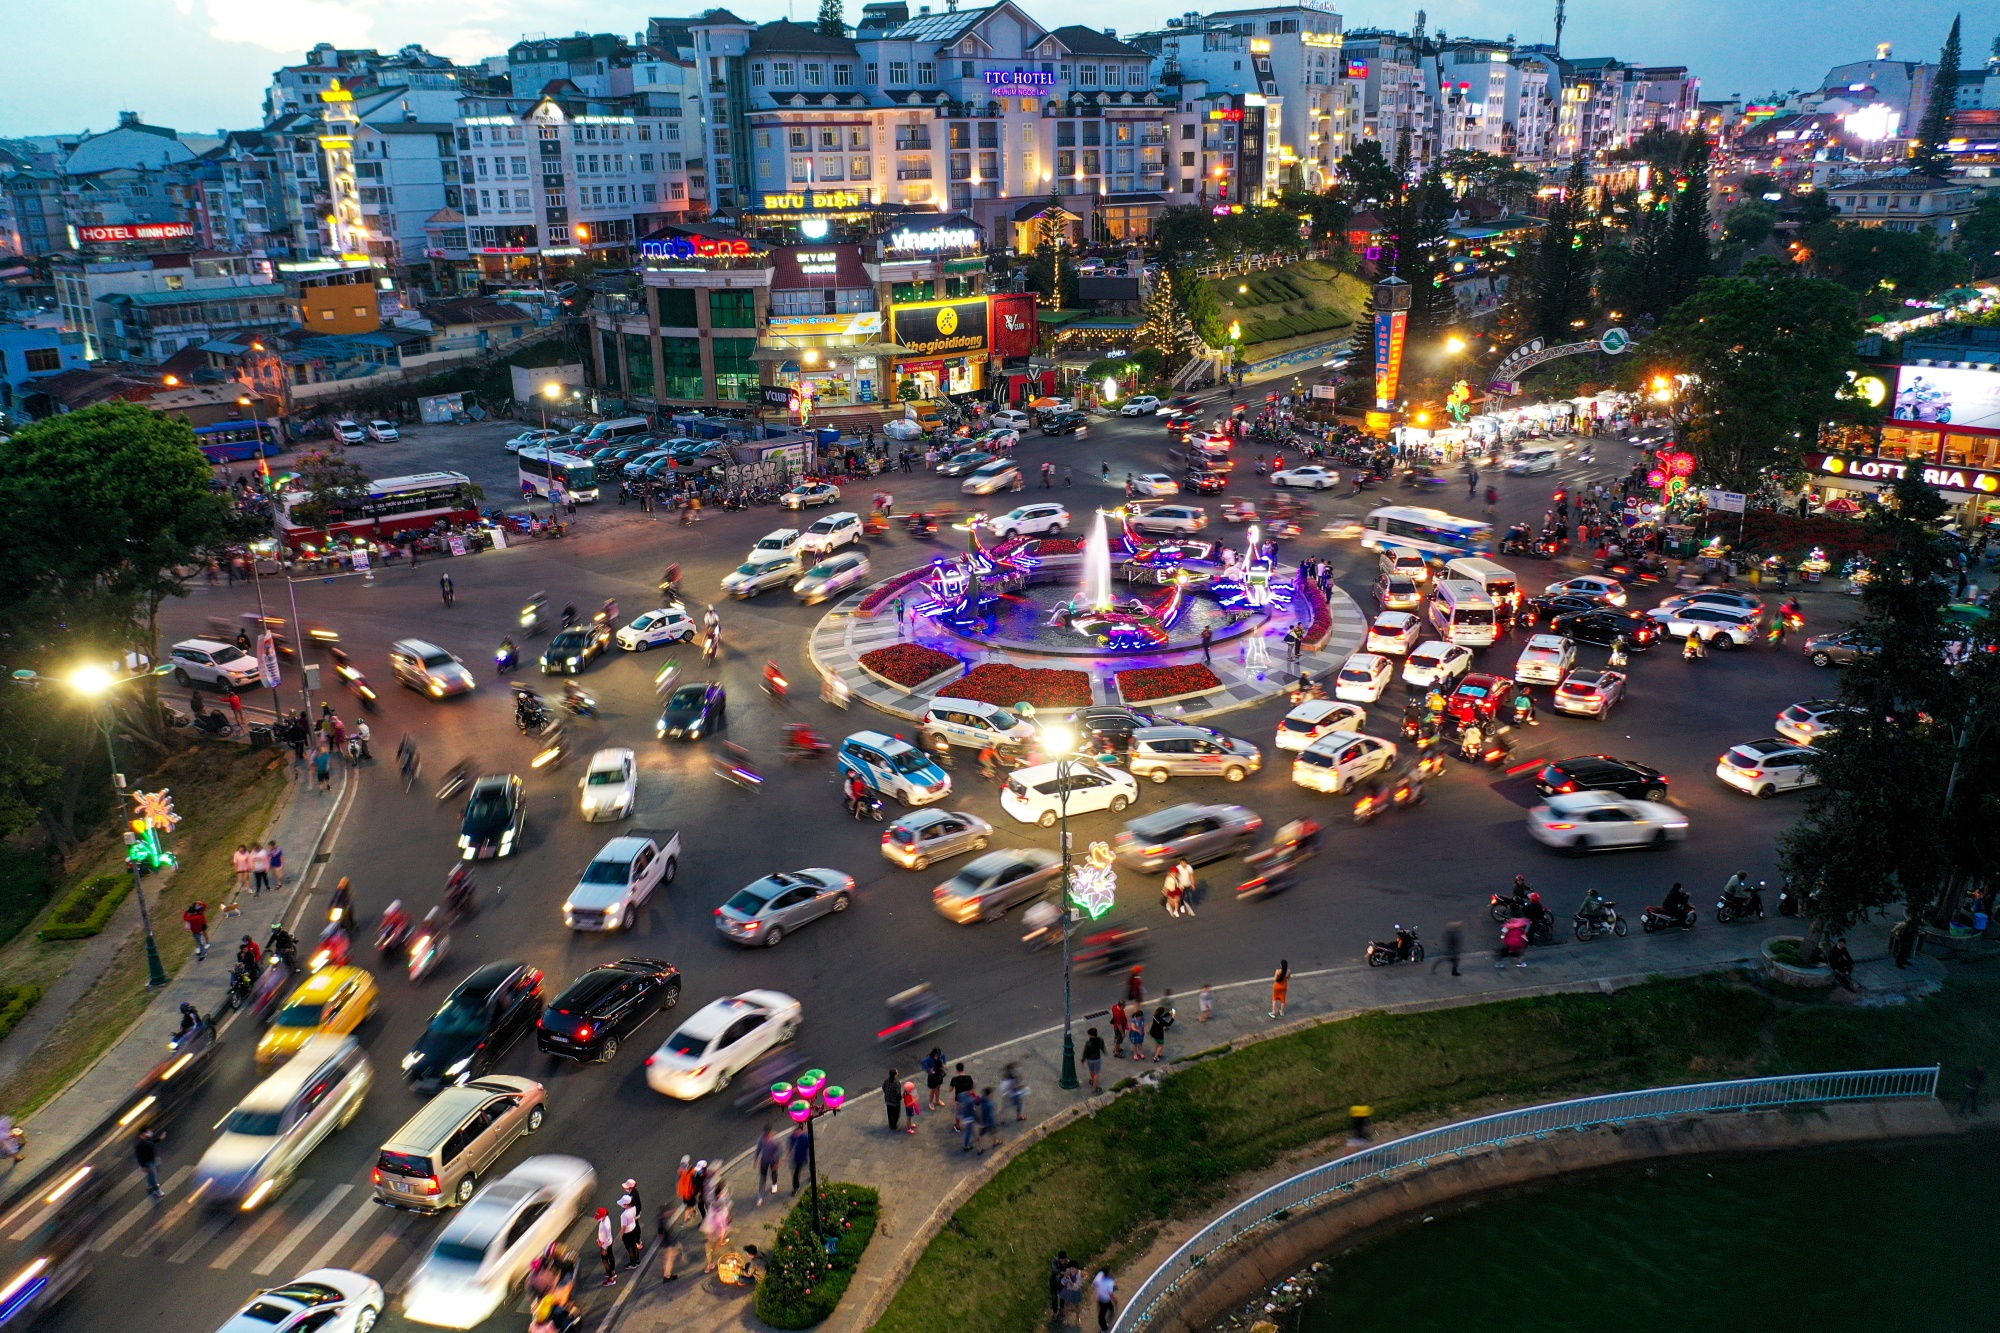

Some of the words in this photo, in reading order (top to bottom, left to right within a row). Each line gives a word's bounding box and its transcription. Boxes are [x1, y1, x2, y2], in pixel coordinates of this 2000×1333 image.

[984, 71, 1009, 84] TTC
[1013, 72, 1055, 85] HOTEL
[765, 195, 804, 209] BƯU
[813, 190, 859, 210] ĐIỆN
[83, 227, 134, 240] HOTEL
[137, 228, 163, 239] MINH
[164, 224, 194, 238] CHÂU
[892, 227, 974, 251] vinaphone
[906, 335, 983, 355] thegioididong
[1849, 460, 1965, 488] LOTTRIA
